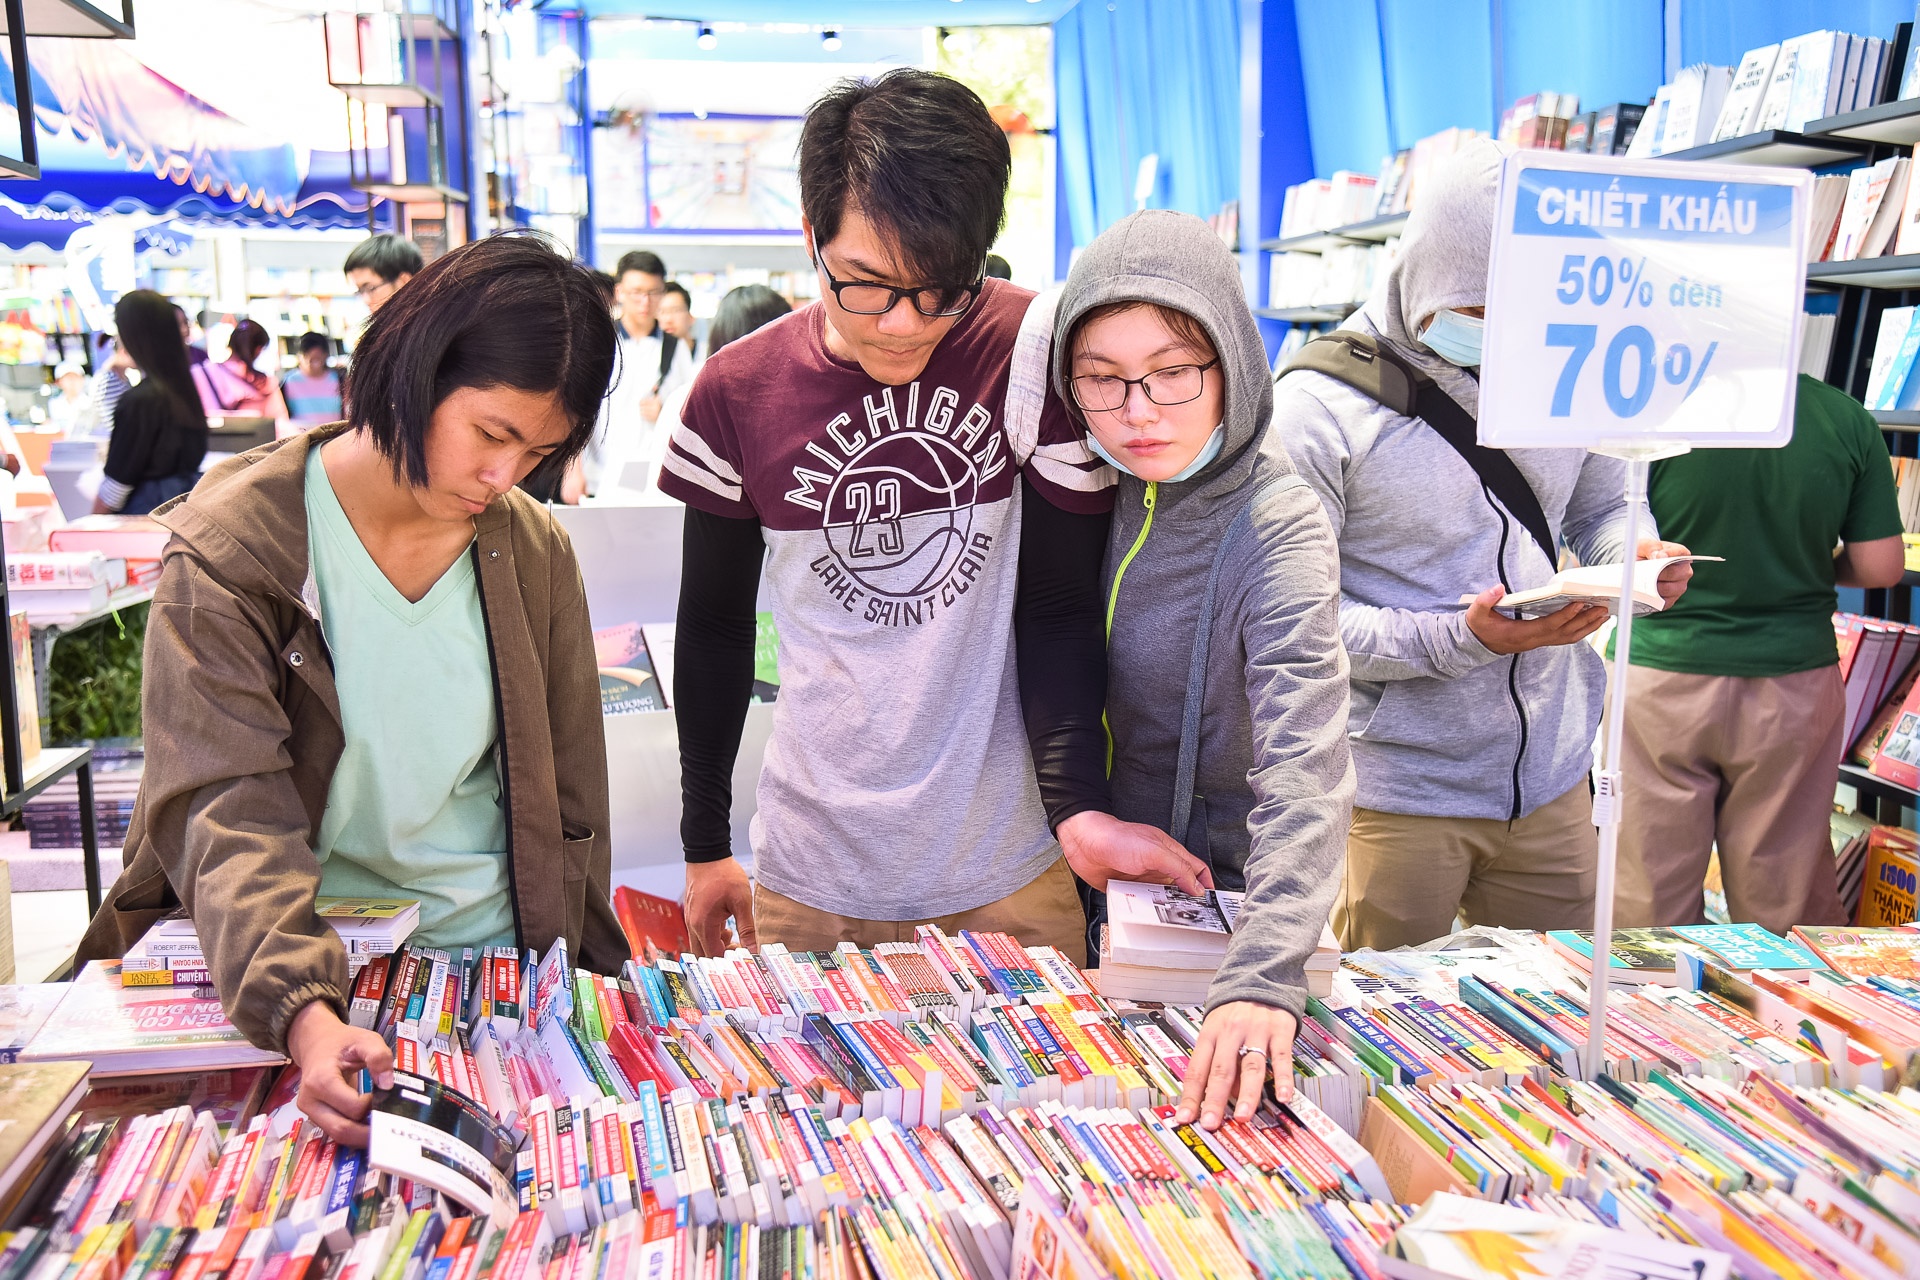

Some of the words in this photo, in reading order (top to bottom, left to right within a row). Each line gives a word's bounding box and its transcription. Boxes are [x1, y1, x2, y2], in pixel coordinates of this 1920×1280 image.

[1537, 178, 1648, 229] CHIẾT
[1659, 185, 1757, 235] KHẤU
[1556, 255, 1653, 308] 50%
[1545, 323, 1719, 419] 70%
[784, 382, 1007, 512] MICHIGAN
[845, 478, 904, 558] 23
[810, 555, 864, 612] LAKE
[942, 532, 993, 608] CLAIR
[864, 595, 936, 627] SAINT
[1880, 862, 1917, 895] 1800
[176, 970, 204, 984] CHUYỆN
[192, 1001, 220, 1013] ON
[1343, 1009, 1366, 1030] HOẶC
[1362, 1024, 1379, 1040] MÊ
[1375, 1033, 1388, 1046] SỰ
